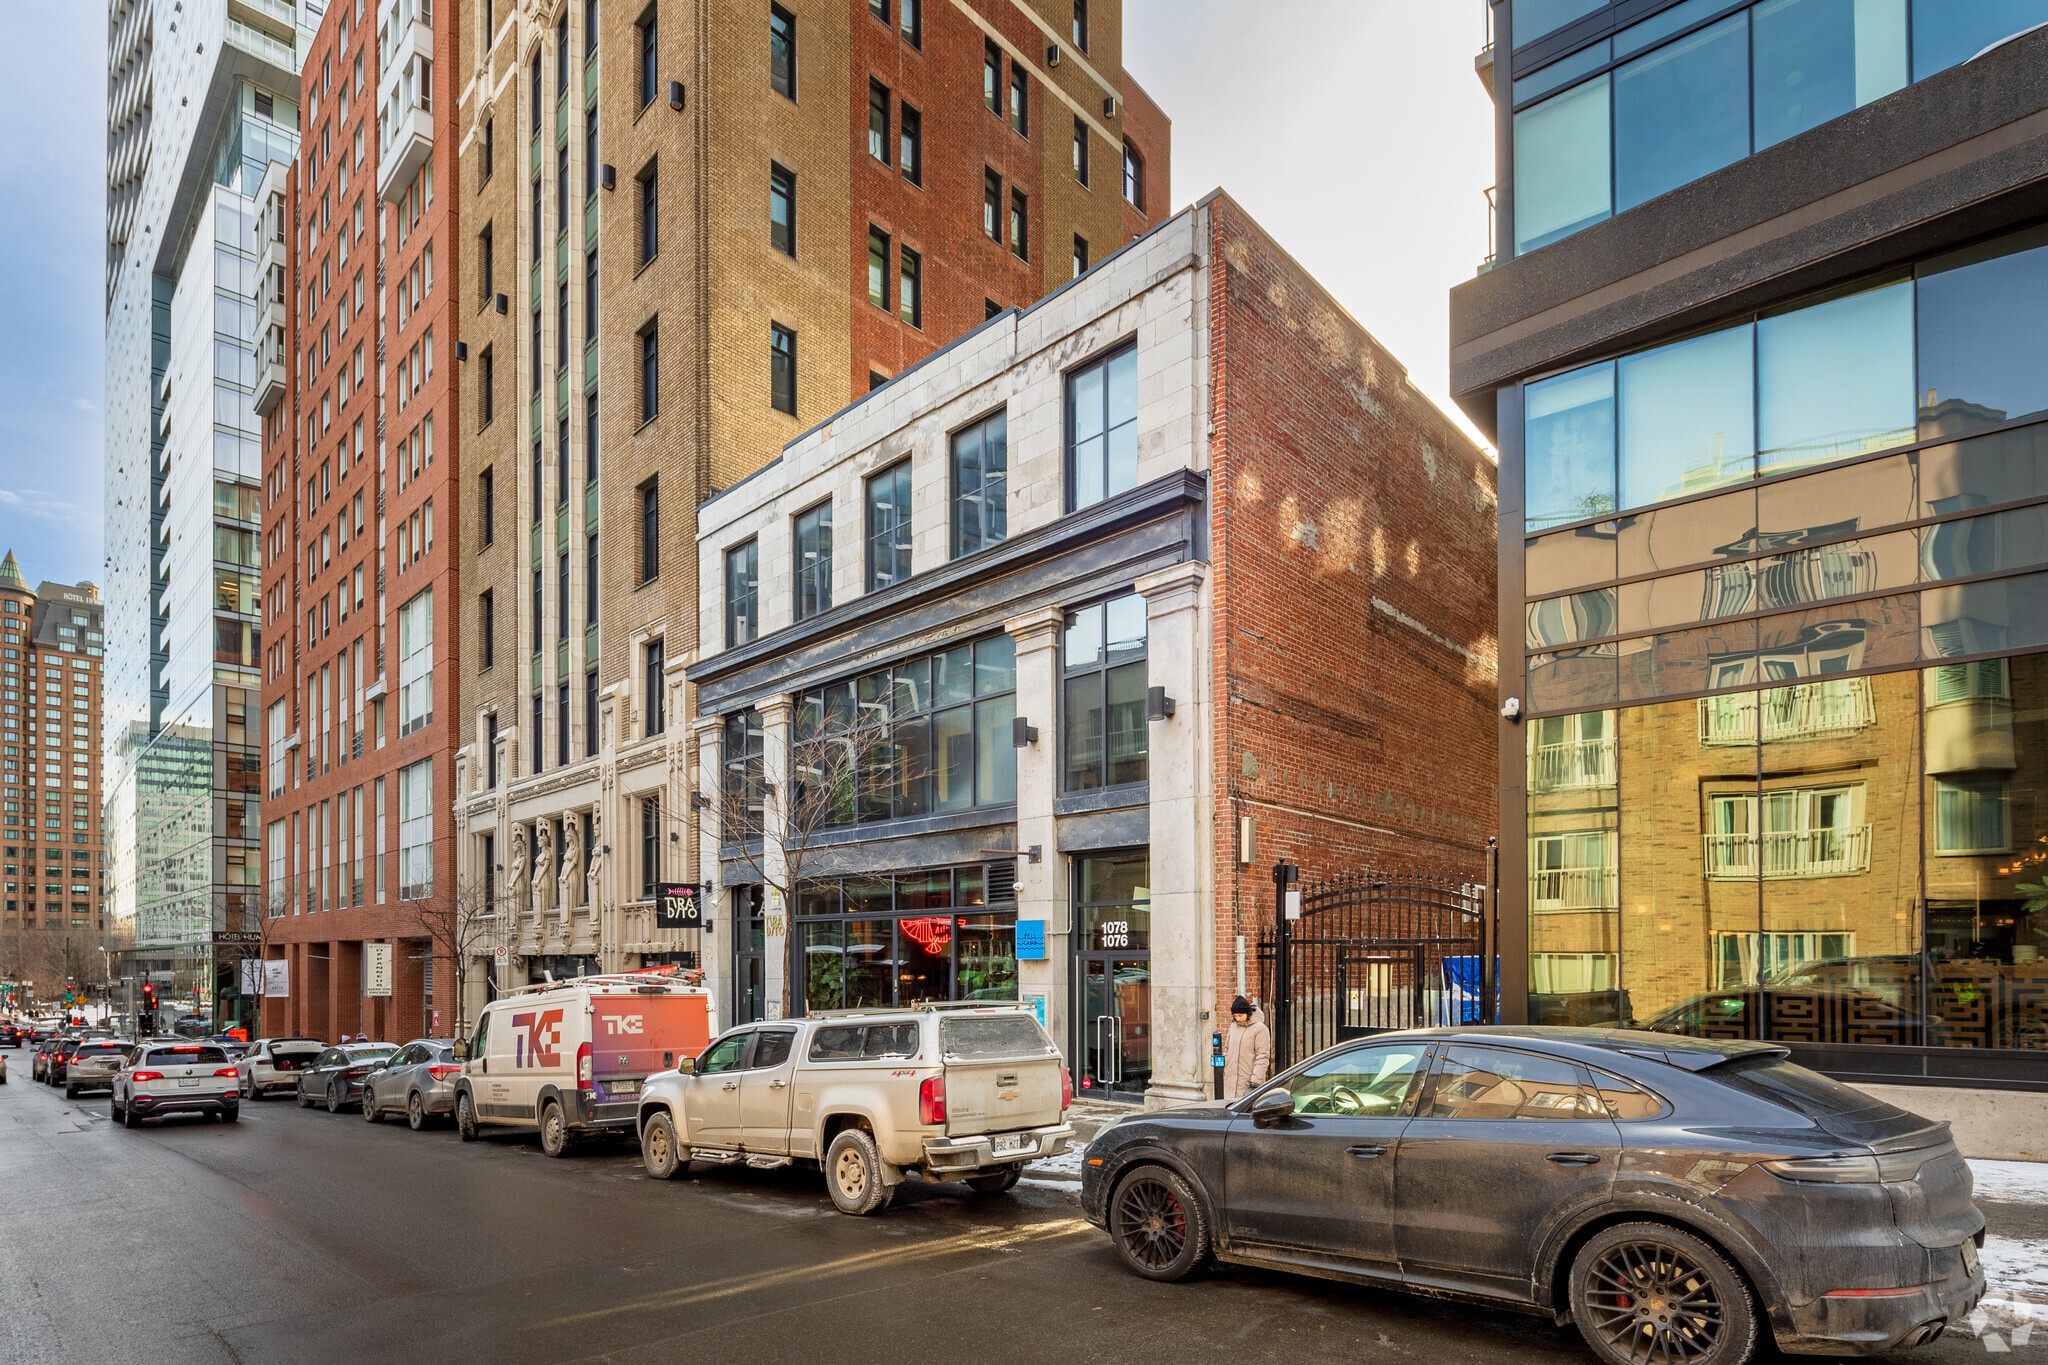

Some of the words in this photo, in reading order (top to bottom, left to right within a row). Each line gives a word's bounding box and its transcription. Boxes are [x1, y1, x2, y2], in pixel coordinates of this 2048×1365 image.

[64, 592, 84, 602] HÔTEL
[1101, 921, 1128, 934] 1078
[218, 932, 240, 940] HÔTEL
[1101, 934, 1128, 947] 1076
[602, 1015, 643, 1034] TKE
[512, 1009, 564, 1068] TKE
